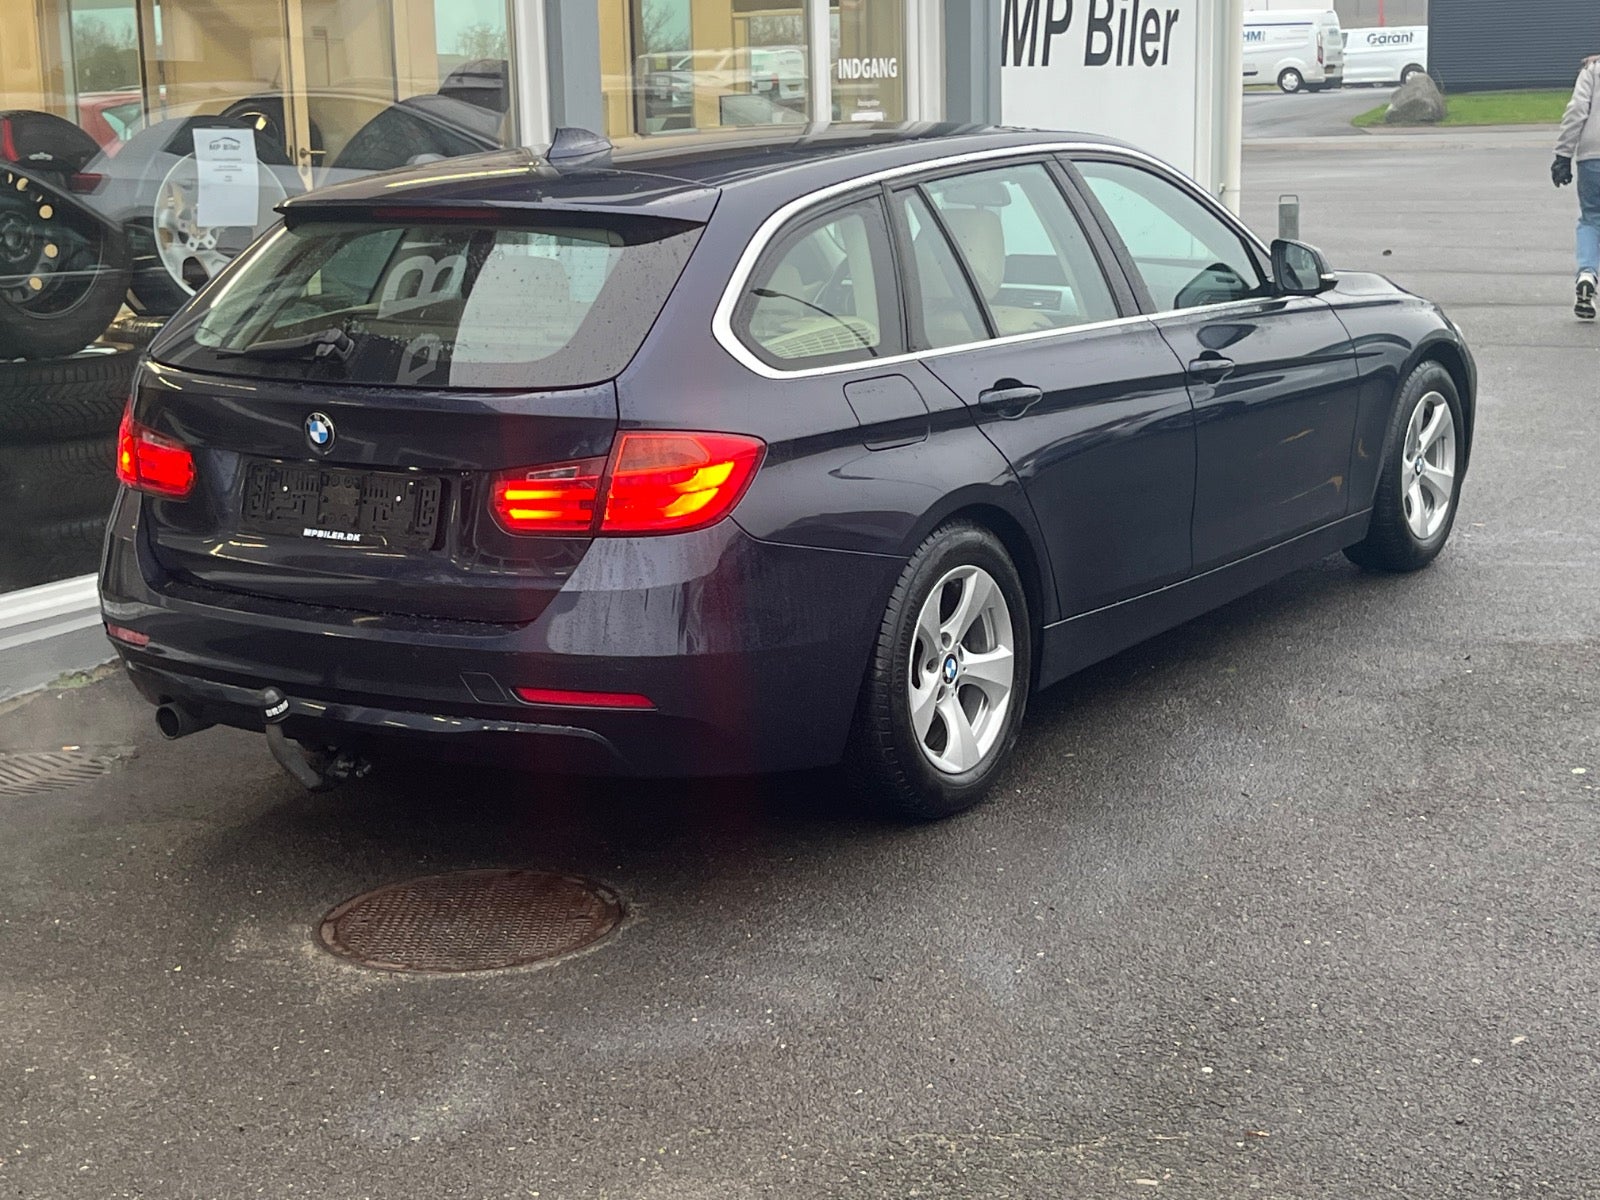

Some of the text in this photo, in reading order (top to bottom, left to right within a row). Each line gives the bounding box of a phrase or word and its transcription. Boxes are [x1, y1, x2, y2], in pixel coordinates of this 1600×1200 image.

[1001, 0, 1180, 67] MP Biler
[1366, 32, 1414, 44] Garant
[838, 57, 898, 79] INDGANG
